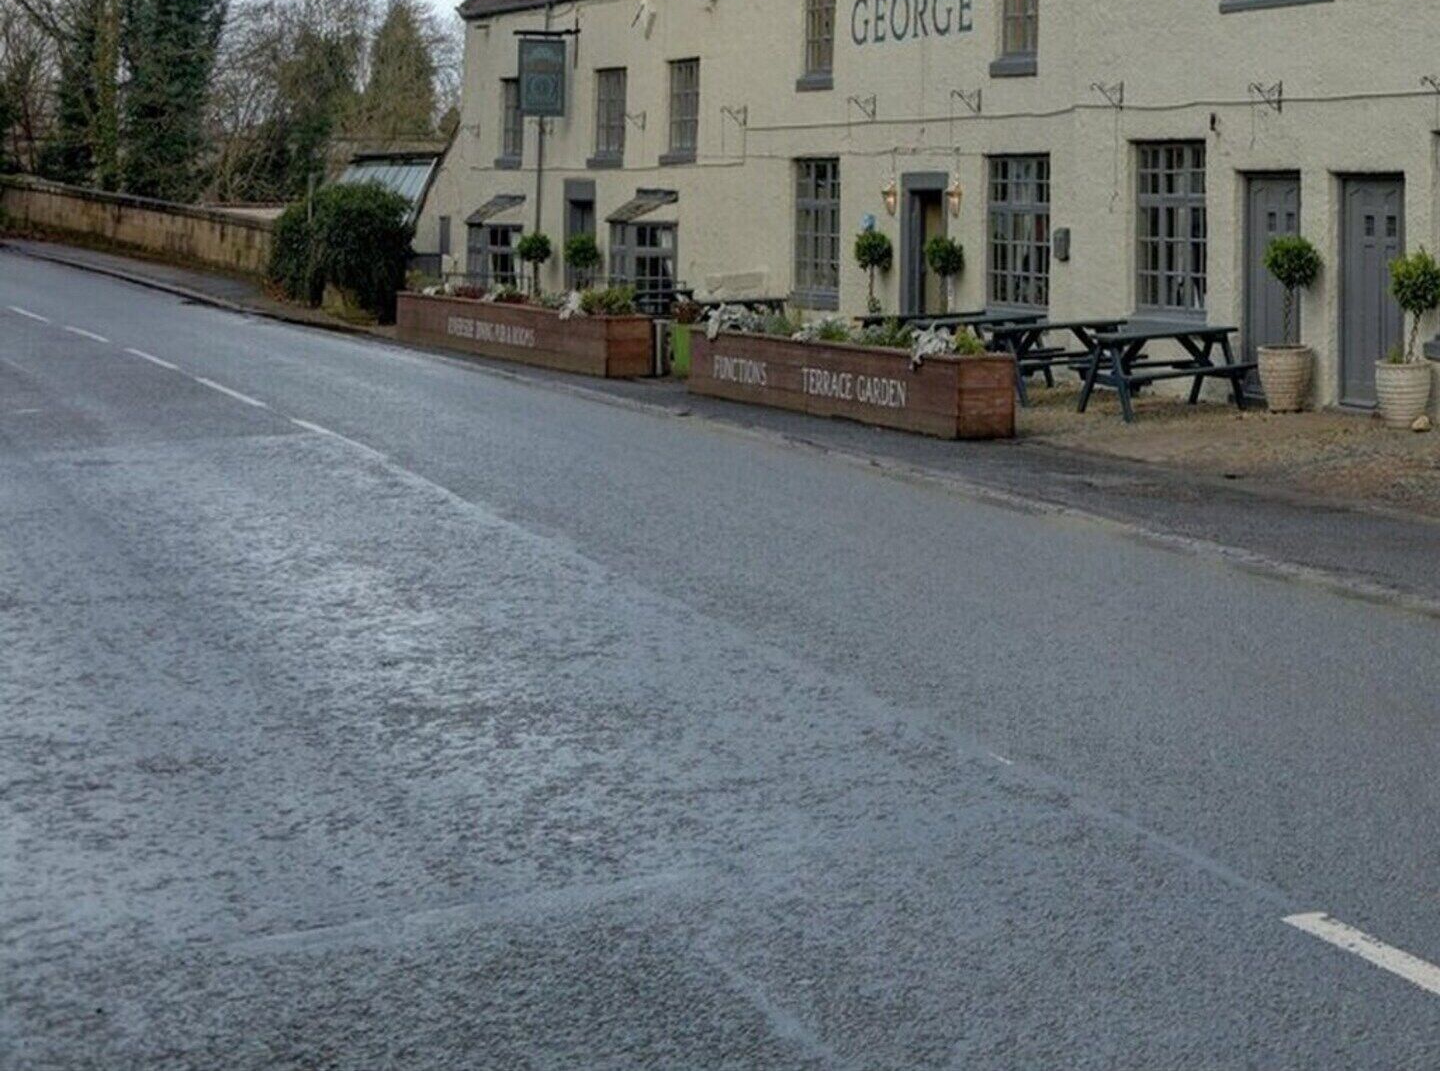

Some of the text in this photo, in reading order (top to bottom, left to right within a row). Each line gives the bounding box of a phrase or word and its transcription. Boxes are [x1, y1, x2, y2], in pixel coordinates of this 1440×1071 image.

[714, 355, 767, 386] FUNCTIONS
[802, 368, 906, 409] TERRACE GARDEN
